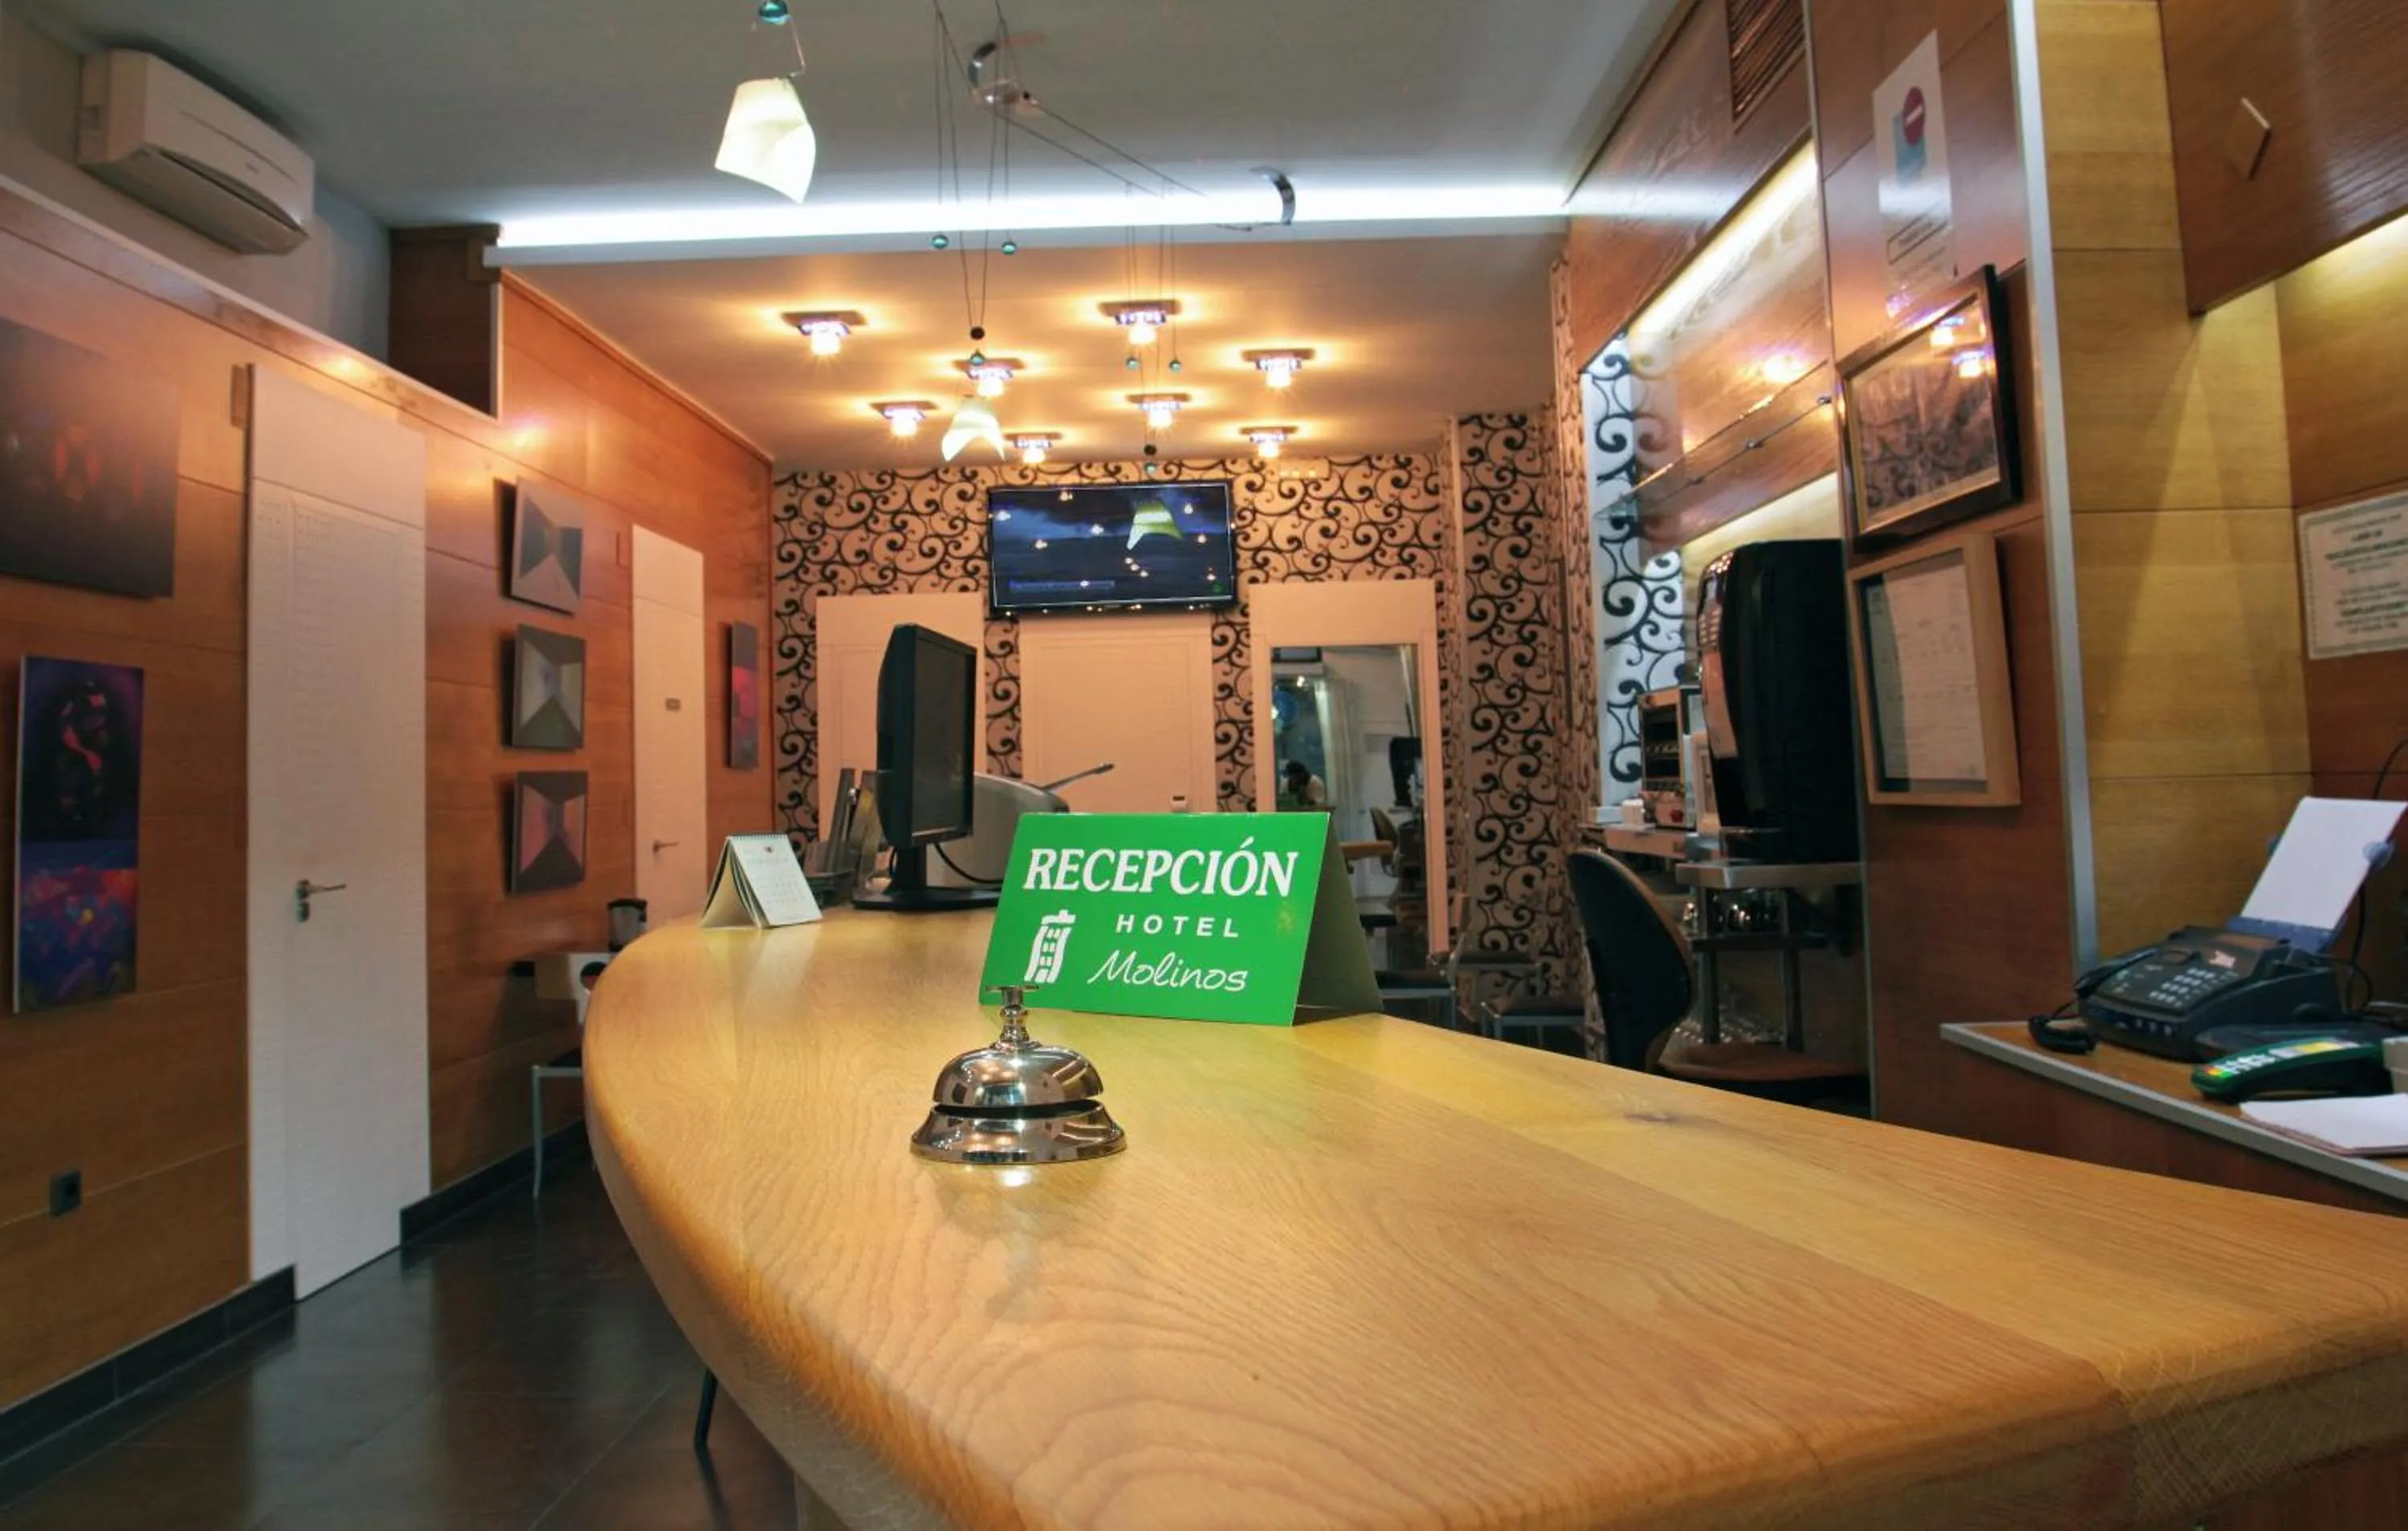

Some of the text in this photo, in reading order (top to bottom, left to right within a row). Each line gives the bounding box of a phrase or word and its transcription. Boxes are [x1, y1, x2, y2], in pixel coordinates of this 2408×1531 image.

[1023, 837, 1300, 898] RECEPCIÓN
[1116, 914, 1239, 938] HOTEL
[1087, 949, 1249, 993] Molinos
